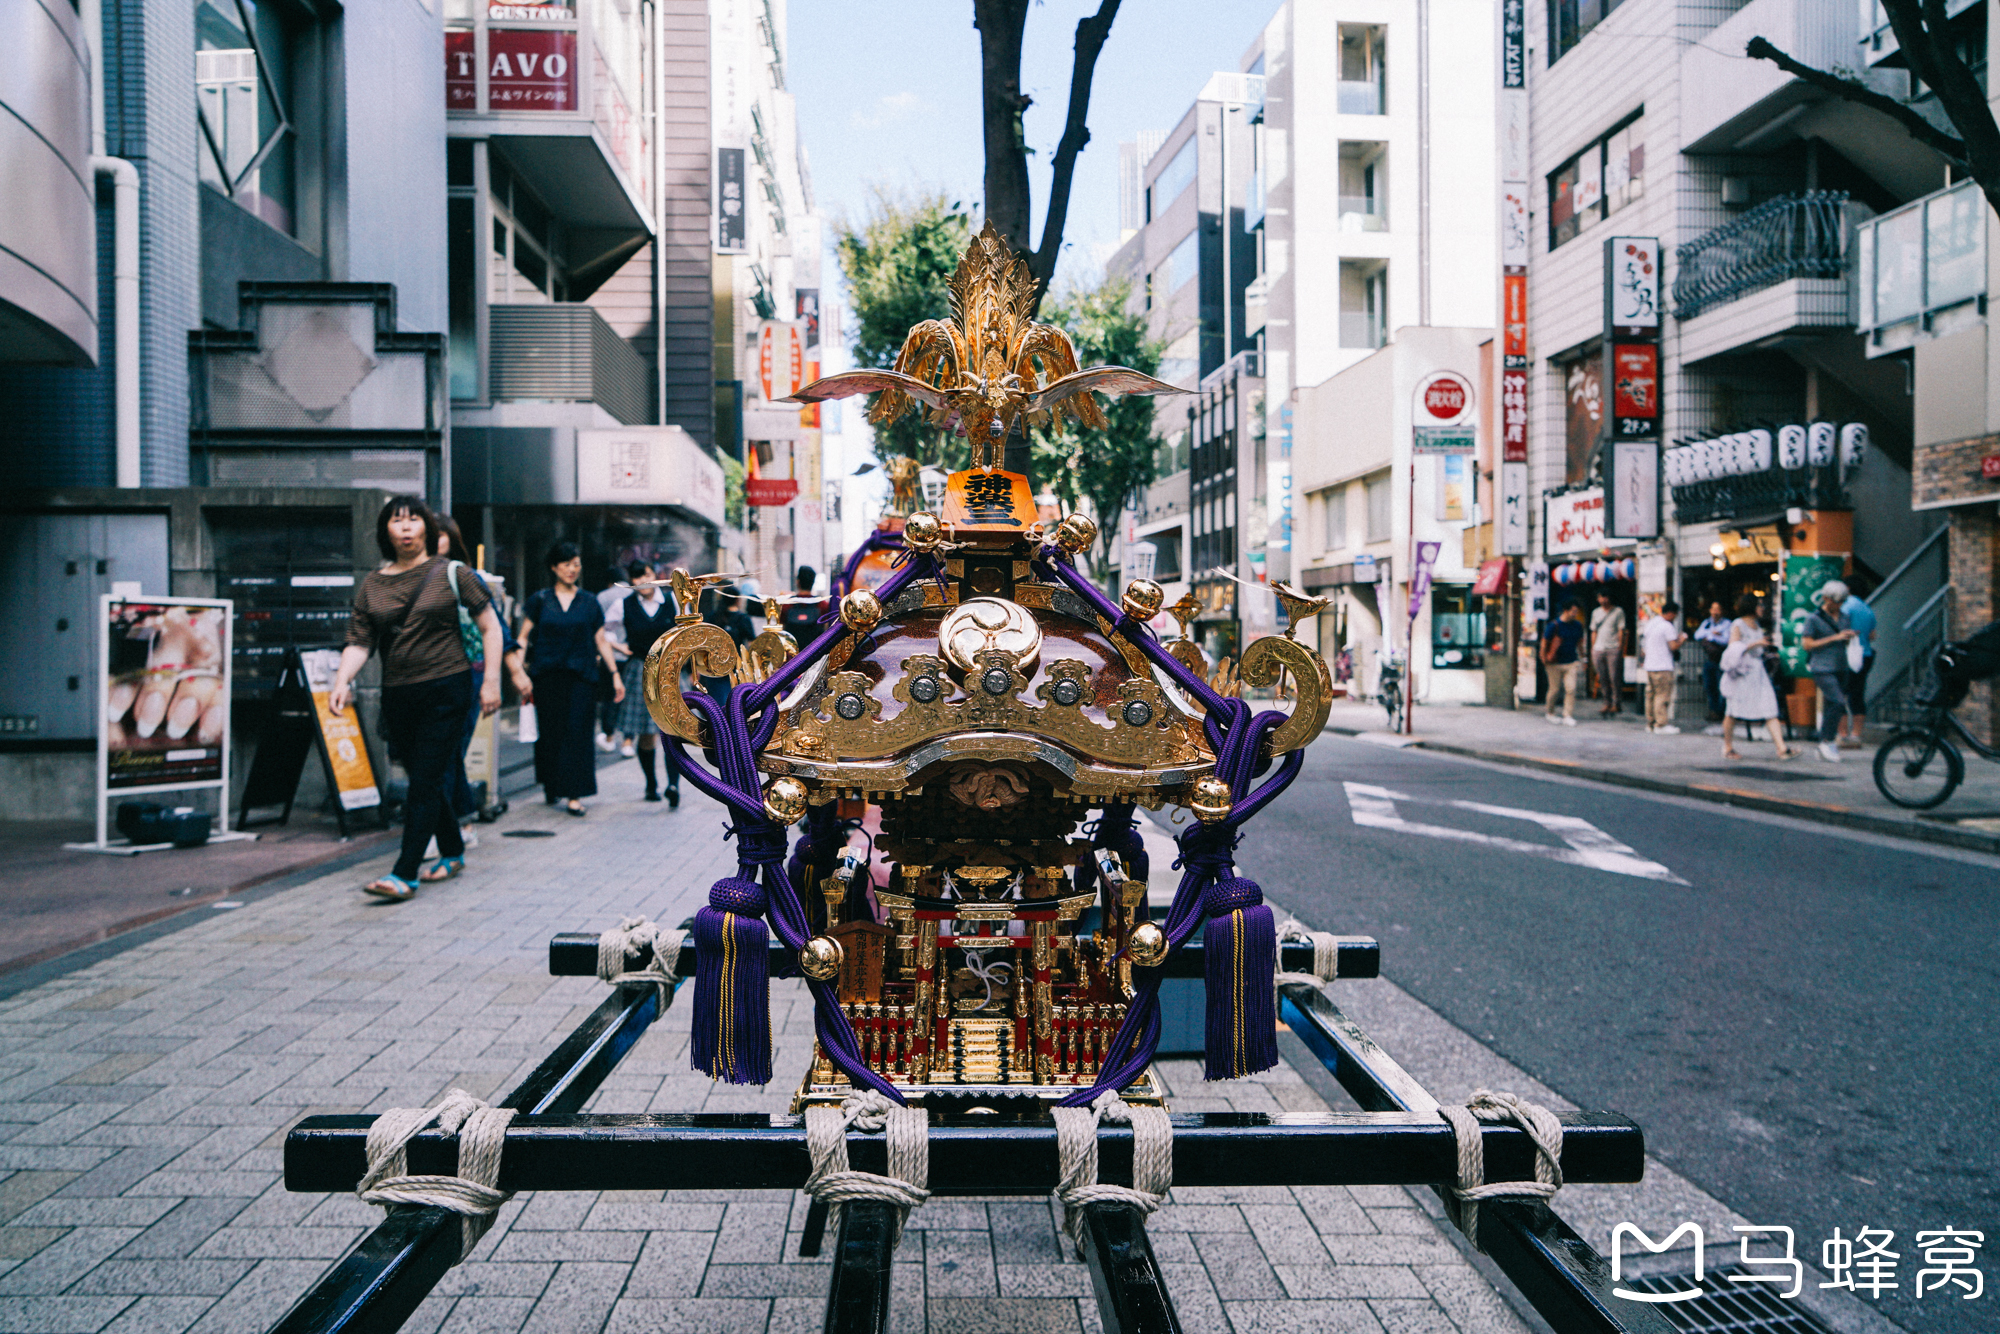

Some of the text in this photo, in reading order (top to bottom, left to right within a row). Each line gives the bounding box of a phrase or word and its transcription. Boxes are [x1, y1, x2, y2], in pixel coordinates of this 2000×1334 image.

[488, 5, 574, 20] GUSTAVO
[1426, 390, 1464, 408] 消火栓
